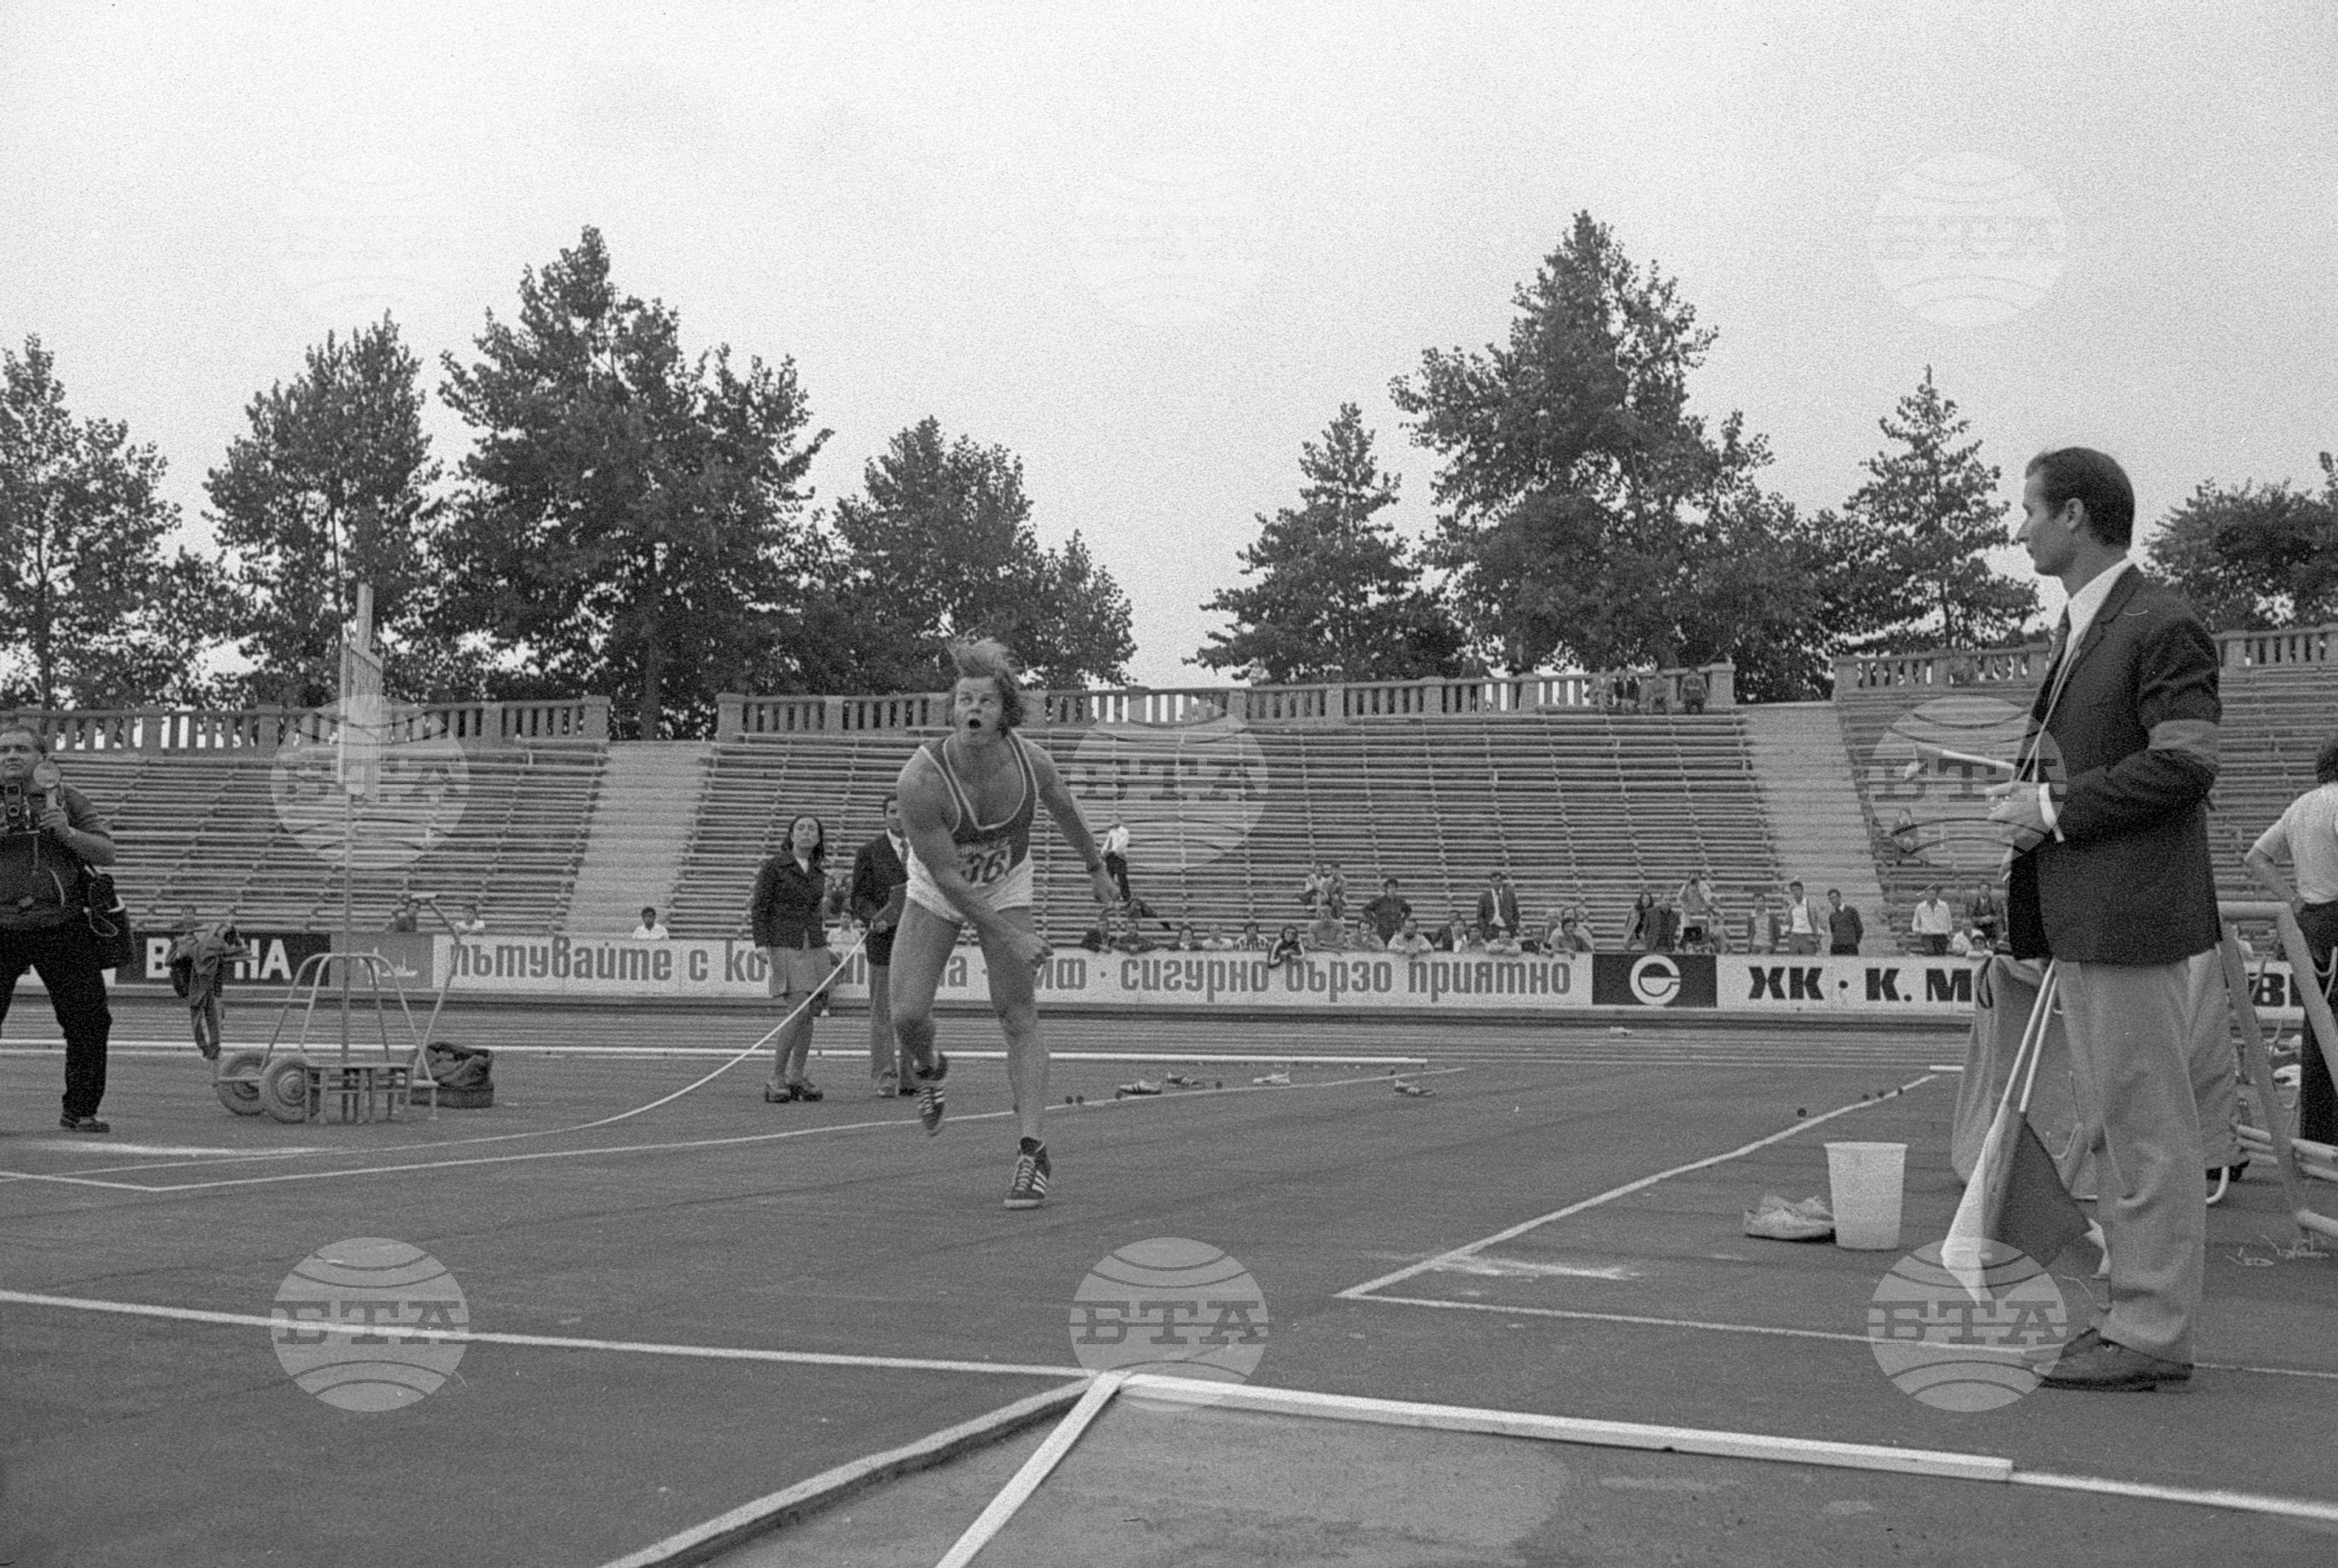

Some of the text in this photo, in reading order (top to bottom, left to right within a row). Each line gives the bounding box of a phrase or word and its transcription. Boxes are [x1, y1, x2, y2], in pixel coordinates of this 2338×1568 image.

[689, 947, 708, 982] с
[1120, 958, 1269, 1003] сигурно
[1408, 960, 1571, 1002] приятно
